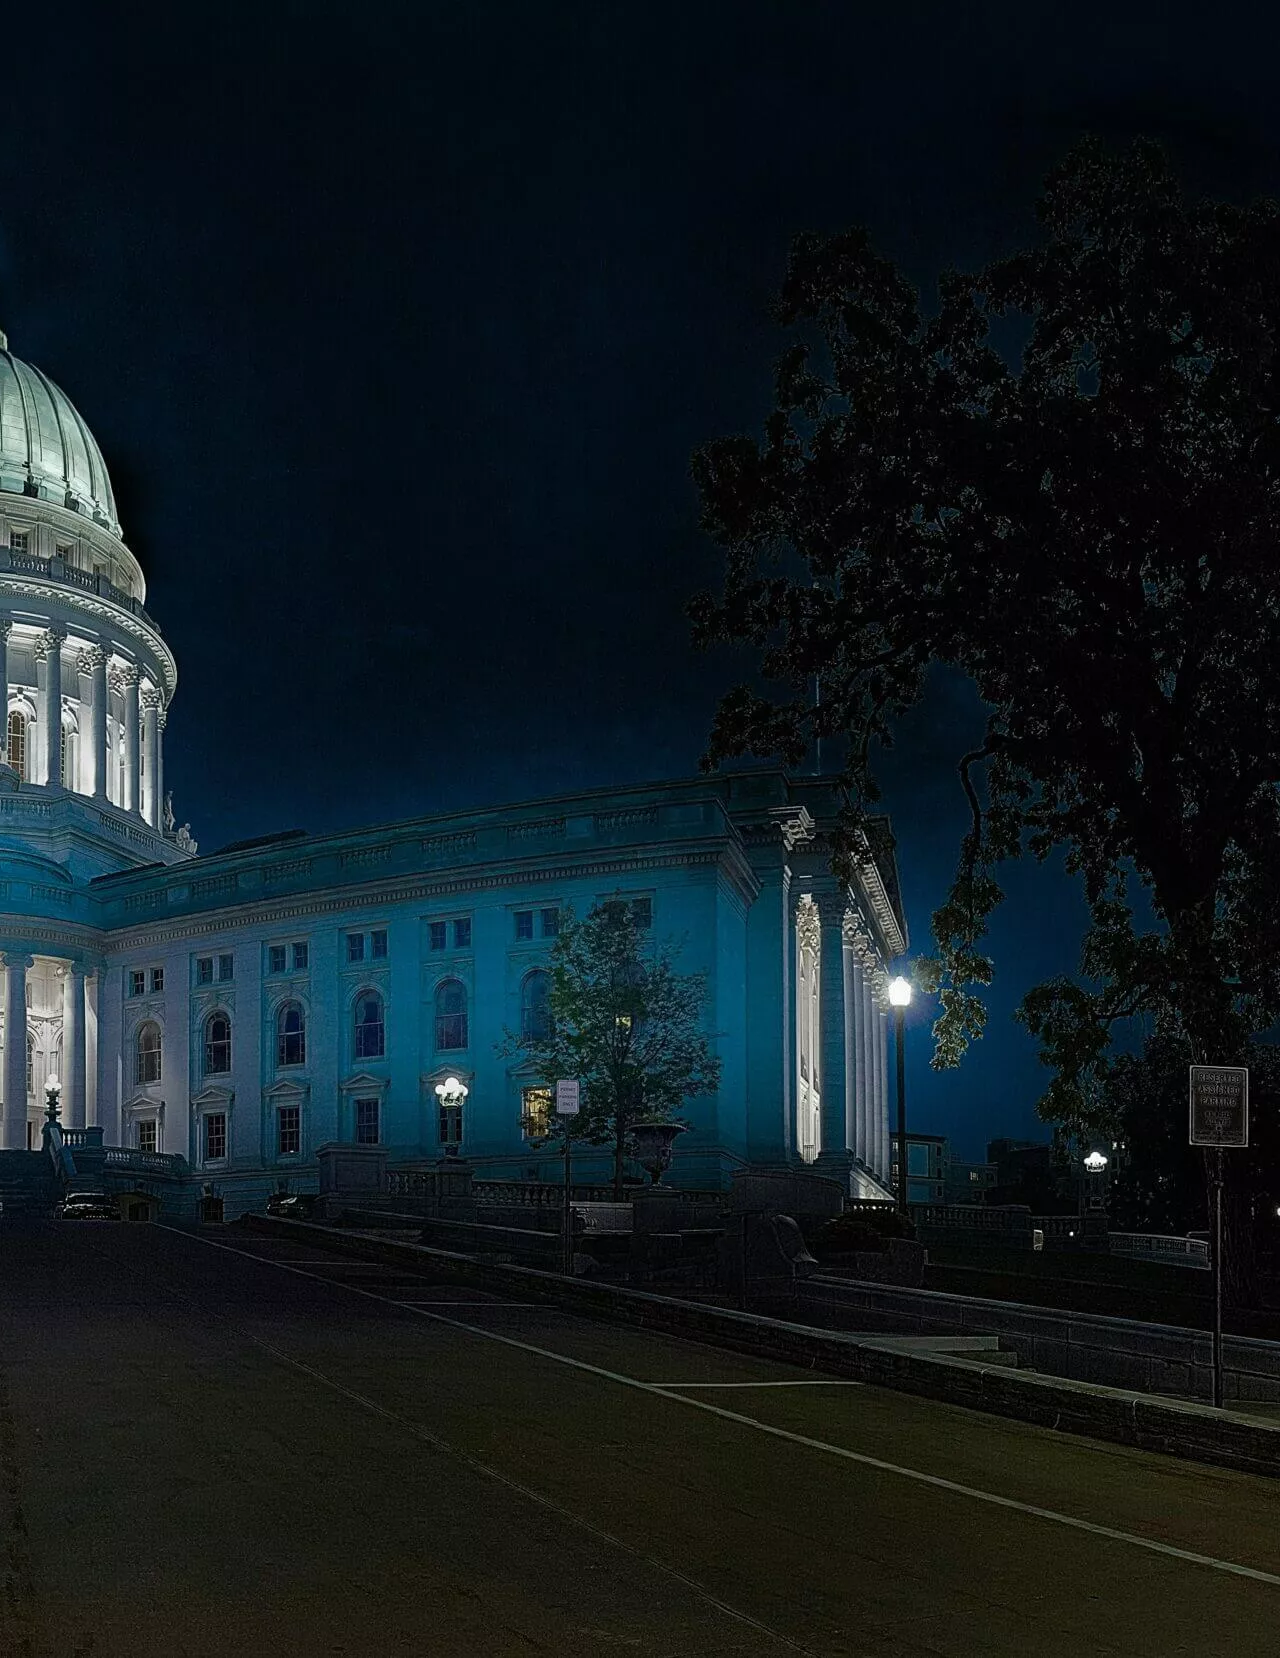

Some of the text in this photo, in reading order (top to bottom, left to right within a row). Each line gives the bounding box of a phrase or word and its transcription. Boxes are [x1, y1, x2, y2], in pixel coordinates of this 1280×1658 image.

[1198, 1073, 1241, 1083] RESERVED
[1199, 1084, 1240, 1095] ASSIGNED
[1201, 1097, 1236, 1107] PARKING
